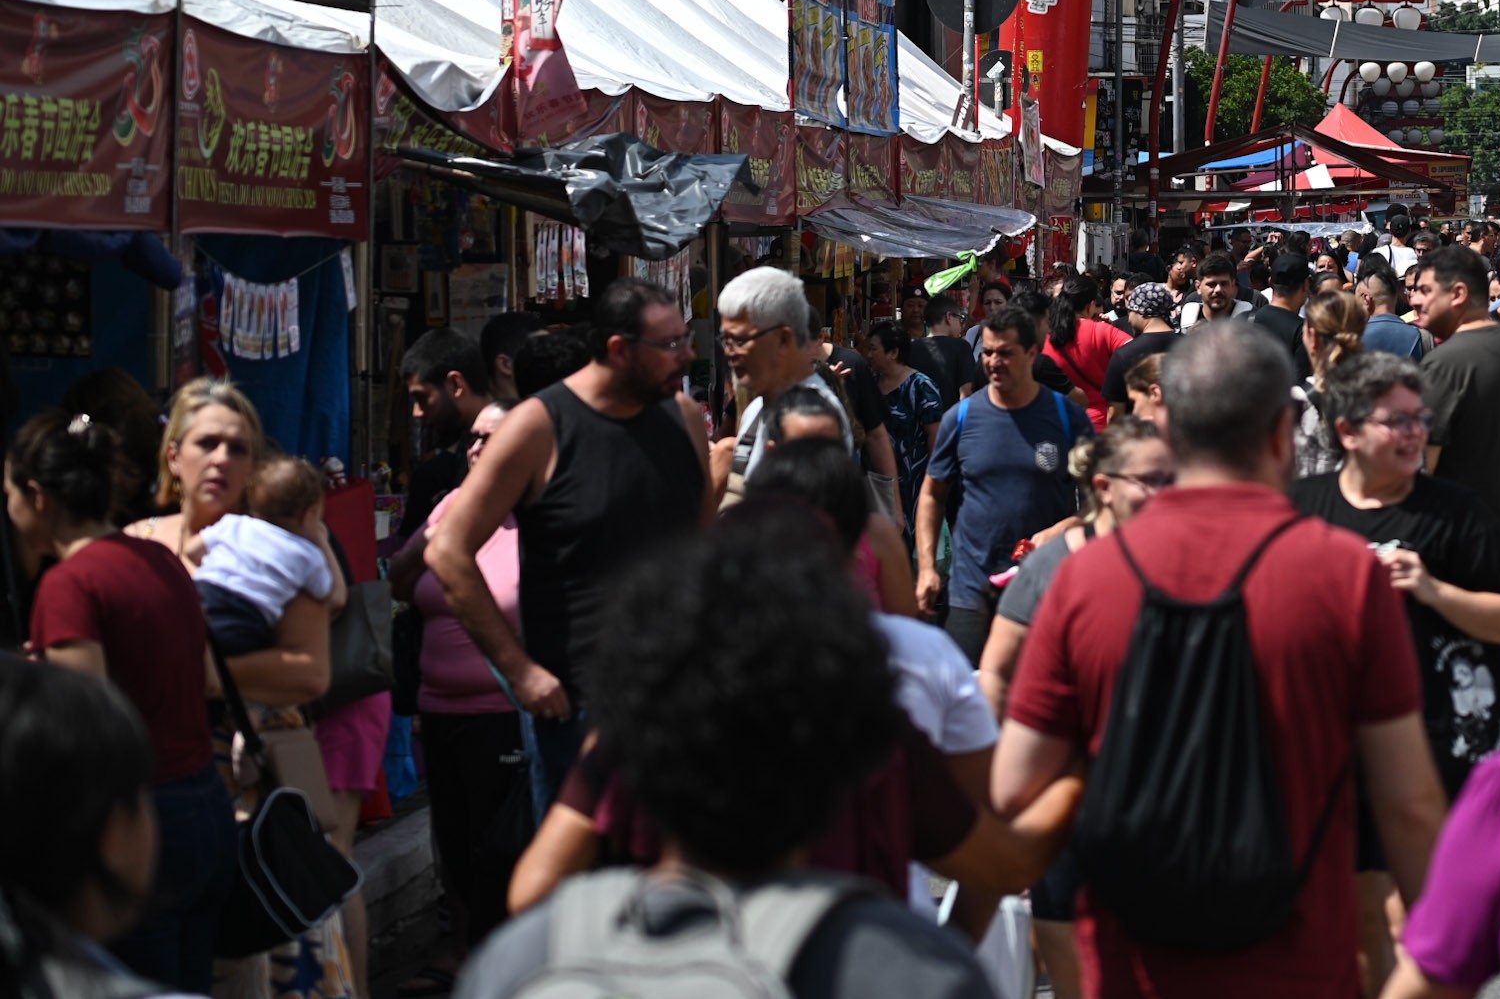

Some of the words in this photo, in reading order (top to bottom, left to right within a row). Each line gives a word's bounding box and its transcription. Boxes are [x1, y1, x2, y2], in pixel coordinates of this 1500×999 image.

[0, 92, 101, 163] 乐春节园游会
